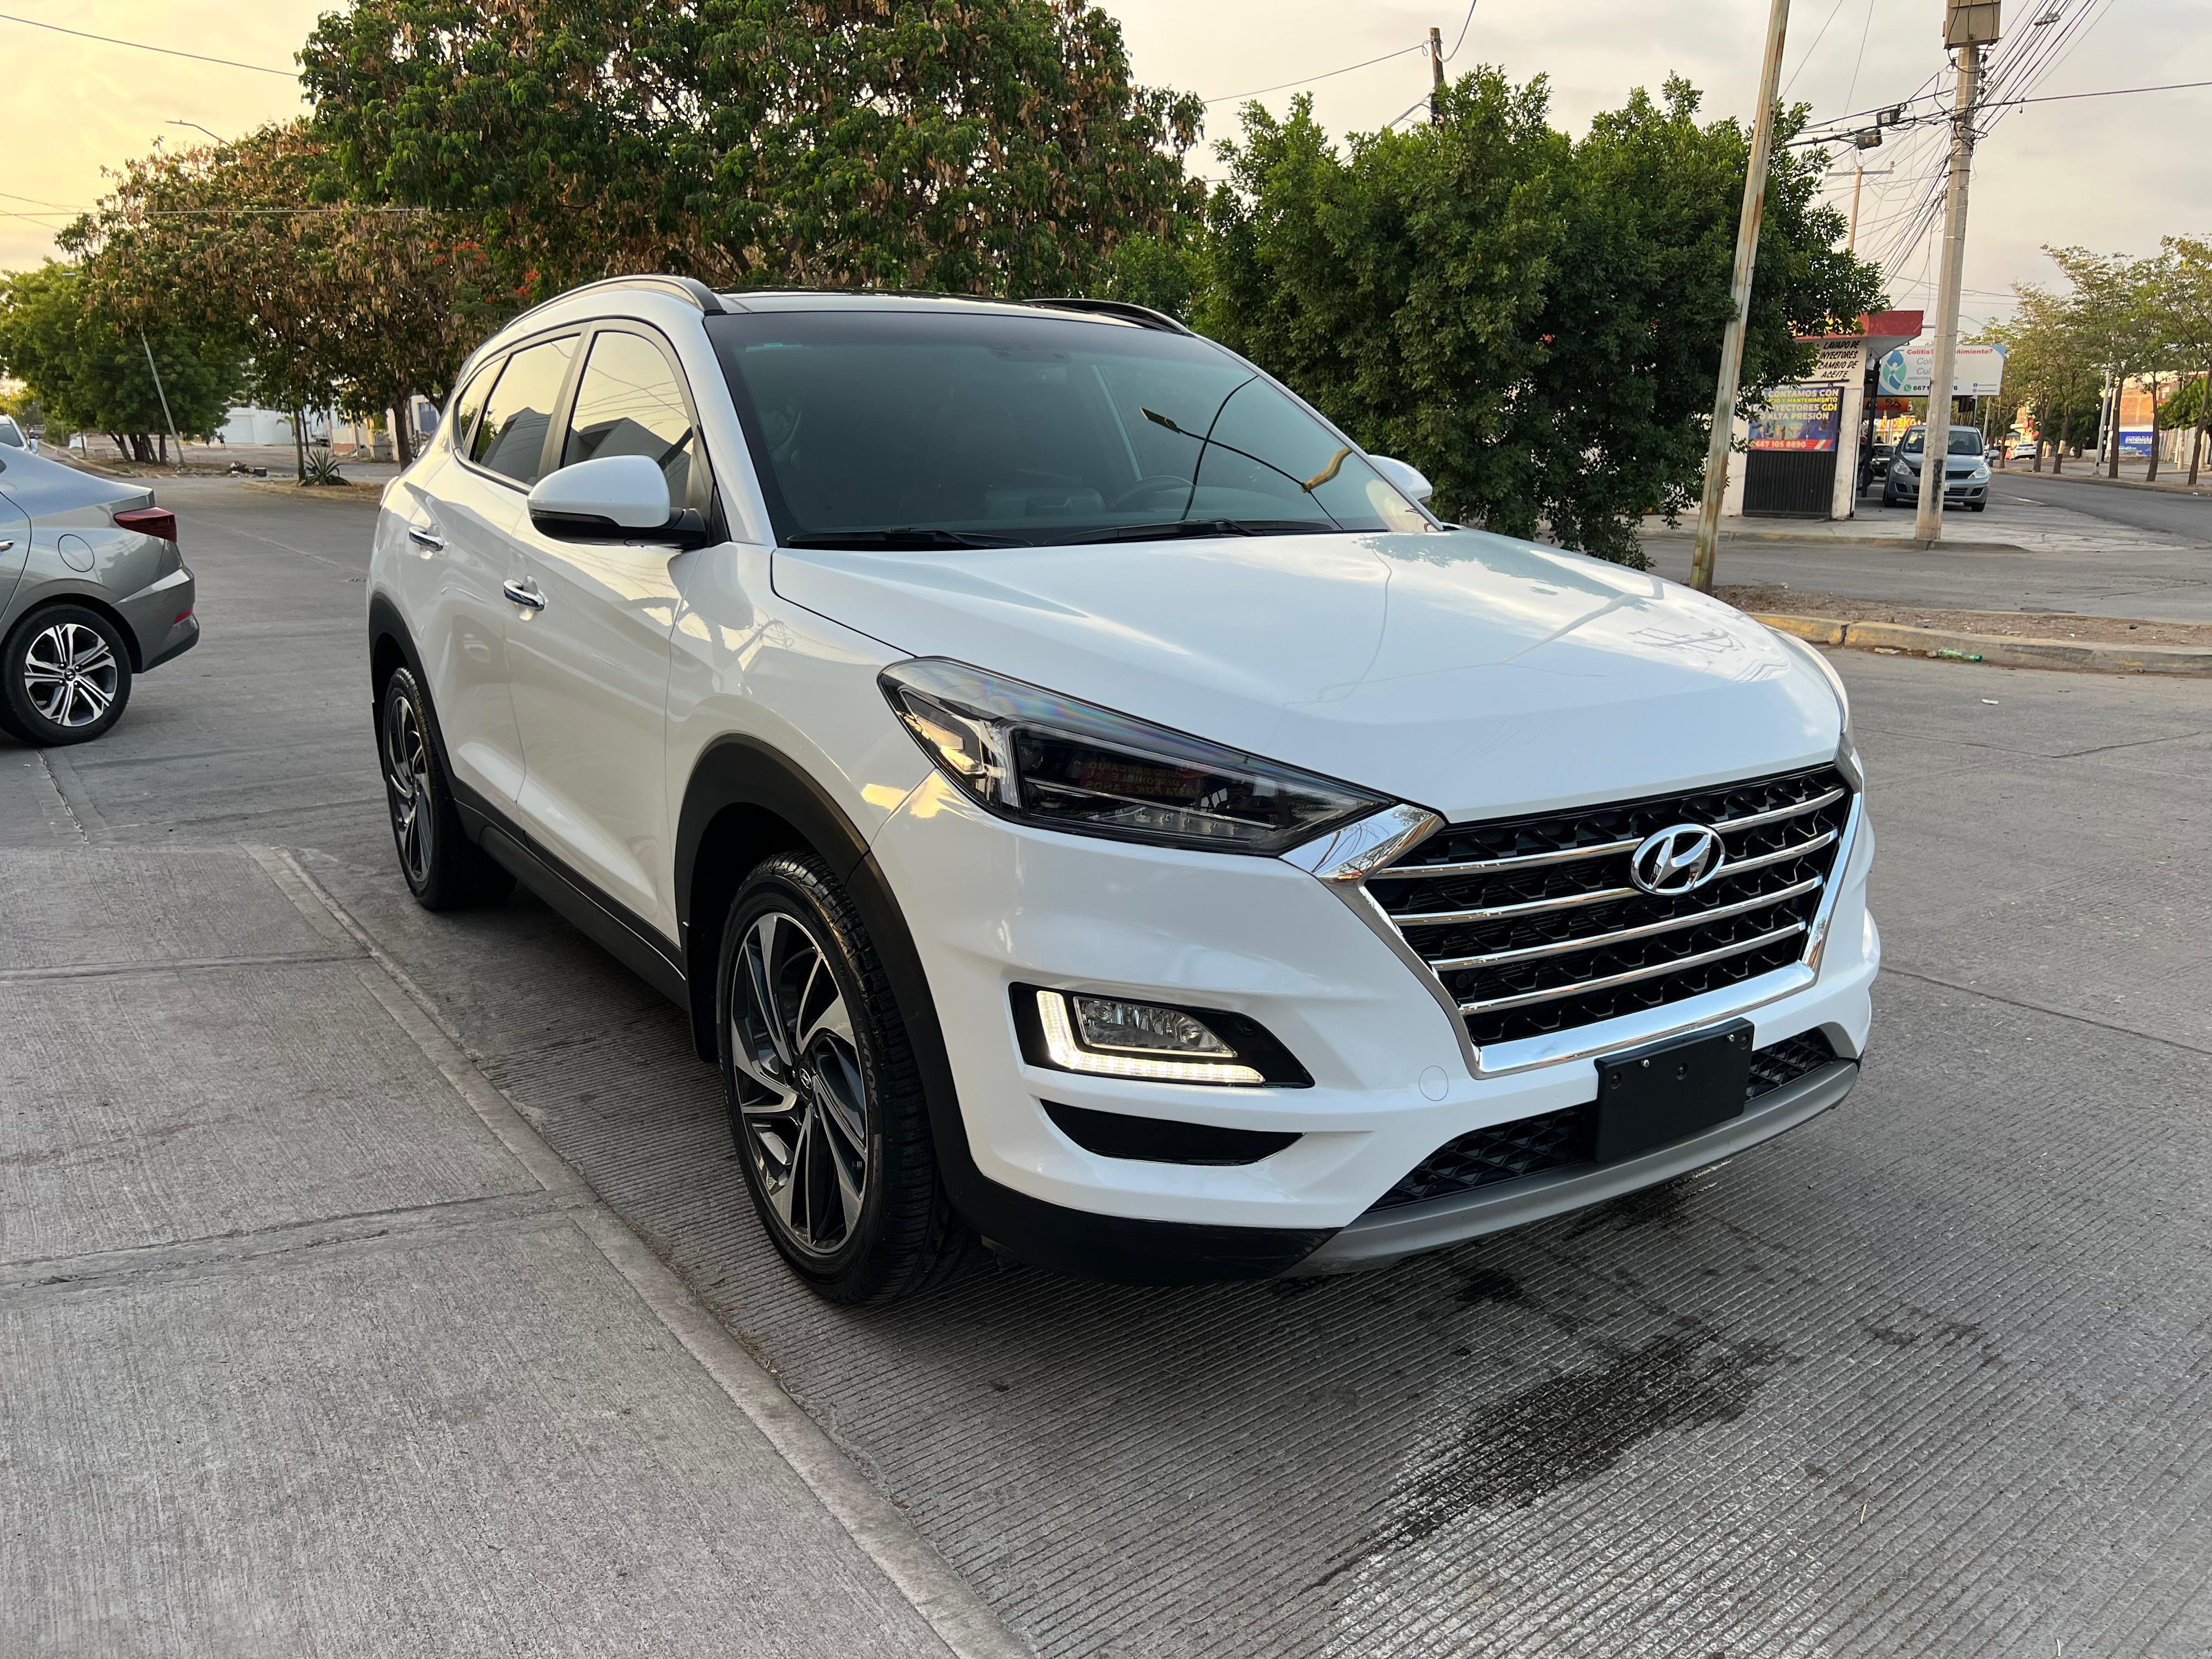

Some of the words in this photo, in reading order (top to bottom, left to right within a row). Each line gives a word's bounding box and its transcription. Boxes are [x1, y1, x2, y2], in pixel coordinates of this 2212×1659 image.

[1823, 341, 1849, 349] LAVADO
[1819, 351, 1858, 359] INYECTORES
[1818, 361, 1846, 369] CAMBIO
[1768, 390, 1819, 398] CONTAMOS
[1821, 403, 1837, 411] GDI
[1791, 411, 1829, 420] PRESIÓN
